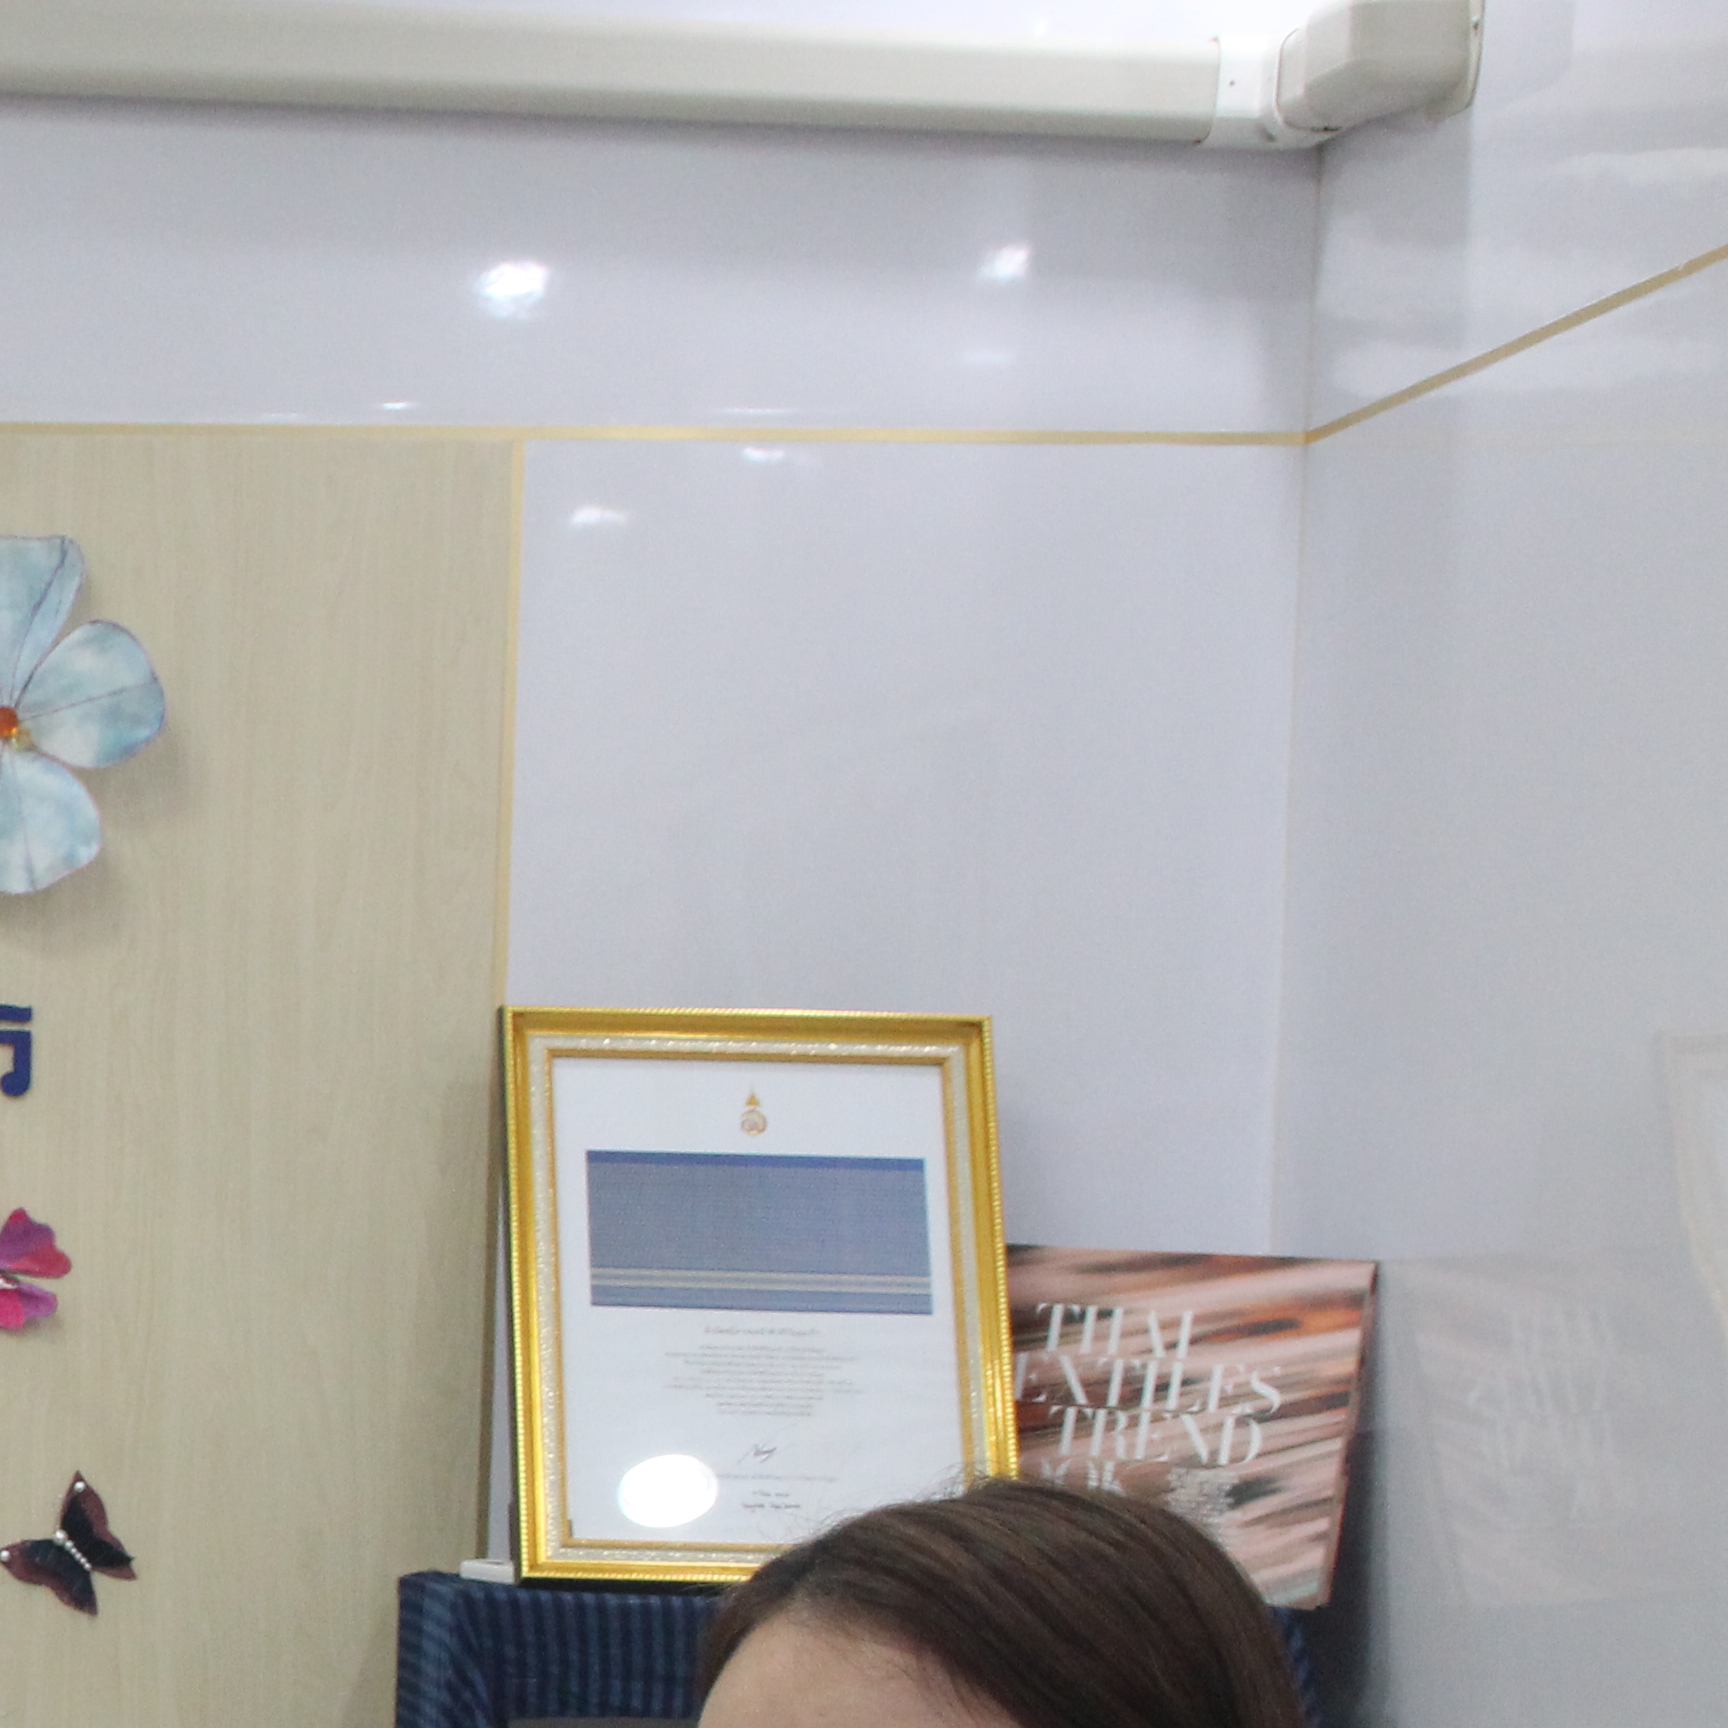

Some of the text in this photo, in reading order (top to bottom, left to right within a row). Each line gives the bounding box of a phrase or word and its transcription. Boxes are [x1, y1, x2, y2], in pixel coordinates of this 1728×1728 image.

[1034, 1301, 1194, 1359] THAI
[1015, 1351, 1282, 1415] EXTILES
[1048, 1404, 1263, 1467] TREND
